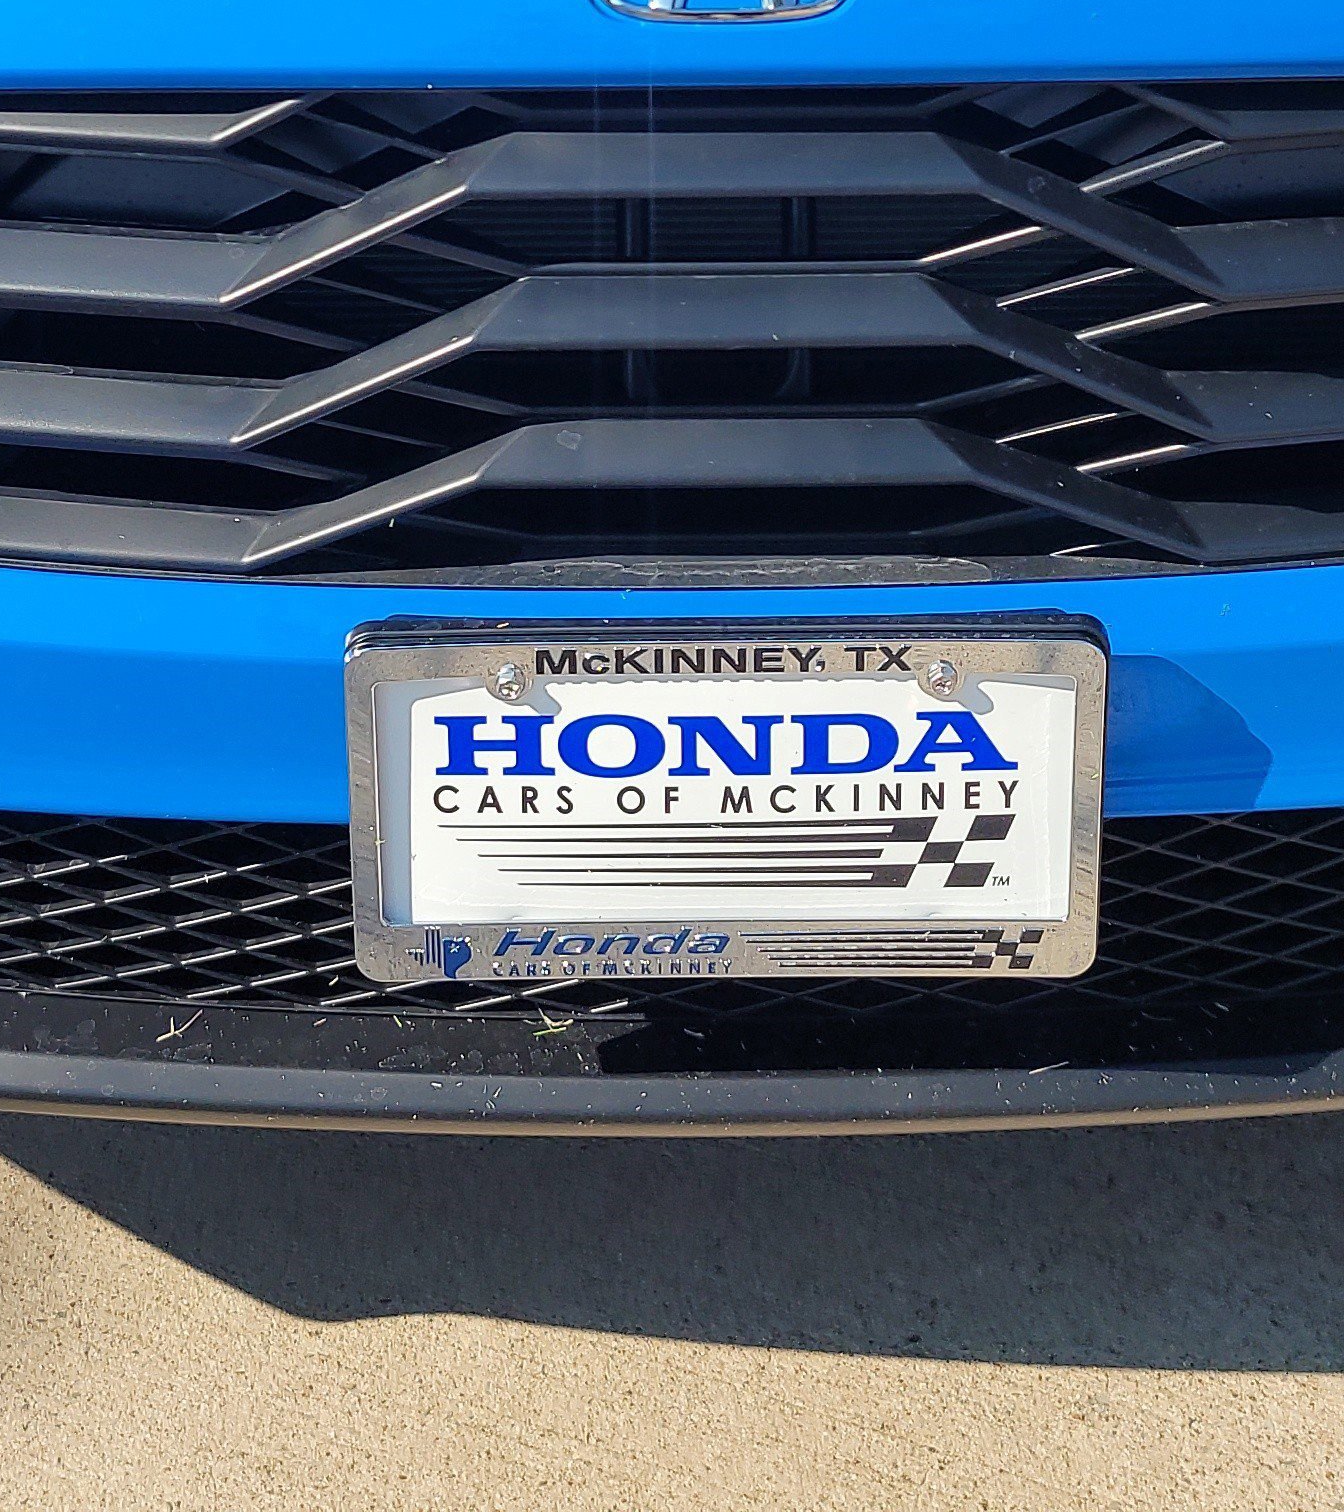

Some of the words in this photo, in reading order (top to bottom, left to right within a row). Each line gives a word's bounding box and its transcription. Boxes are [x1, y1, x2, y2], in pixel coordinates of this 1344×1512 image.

[844, 644, 913, 673] TX
[433, 710, 1019, 778] HONDA
[433, 785, 575, 815] CARS
[616, 784, 681, 815] OF
[720, 780, 1020, 815] MCKINNEY
[492, 926, 731, 956] Honda
[492, 960, 553, 976] CARS
[563, 960, 592, 976] OF
